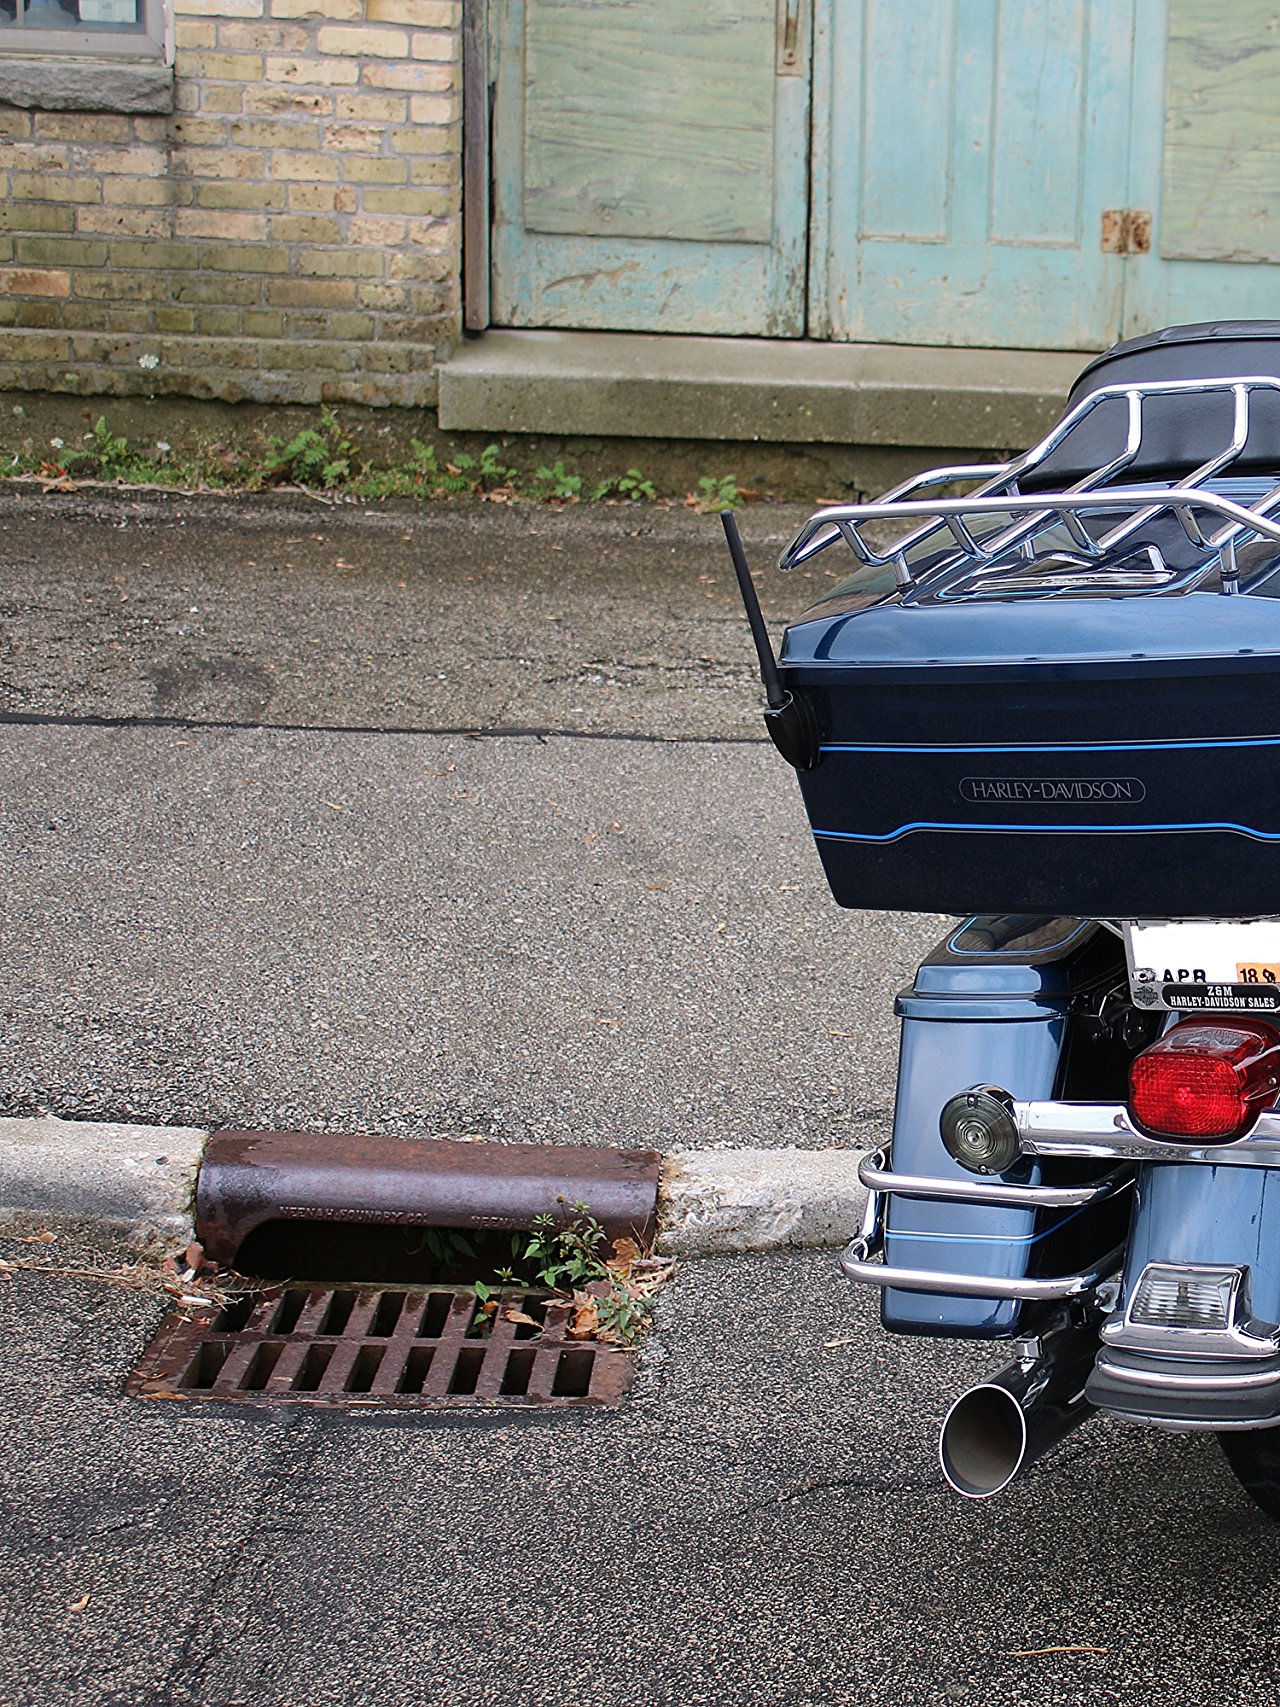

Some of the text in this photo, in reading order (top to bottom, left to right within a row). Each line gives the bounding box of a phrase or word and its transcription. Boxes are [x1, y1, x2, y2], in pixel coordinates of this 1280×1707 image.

[972, 782, 1132, 799] HARLEY-DAVIDSON
[1162, 968, 1206, 983] APR
[1240, 968, 1259, 983] 18
[1206, 986, 1233, 996] Z&M
[1170, 996, 1276, 1008] HARLEY-DAVIDSON SALES
